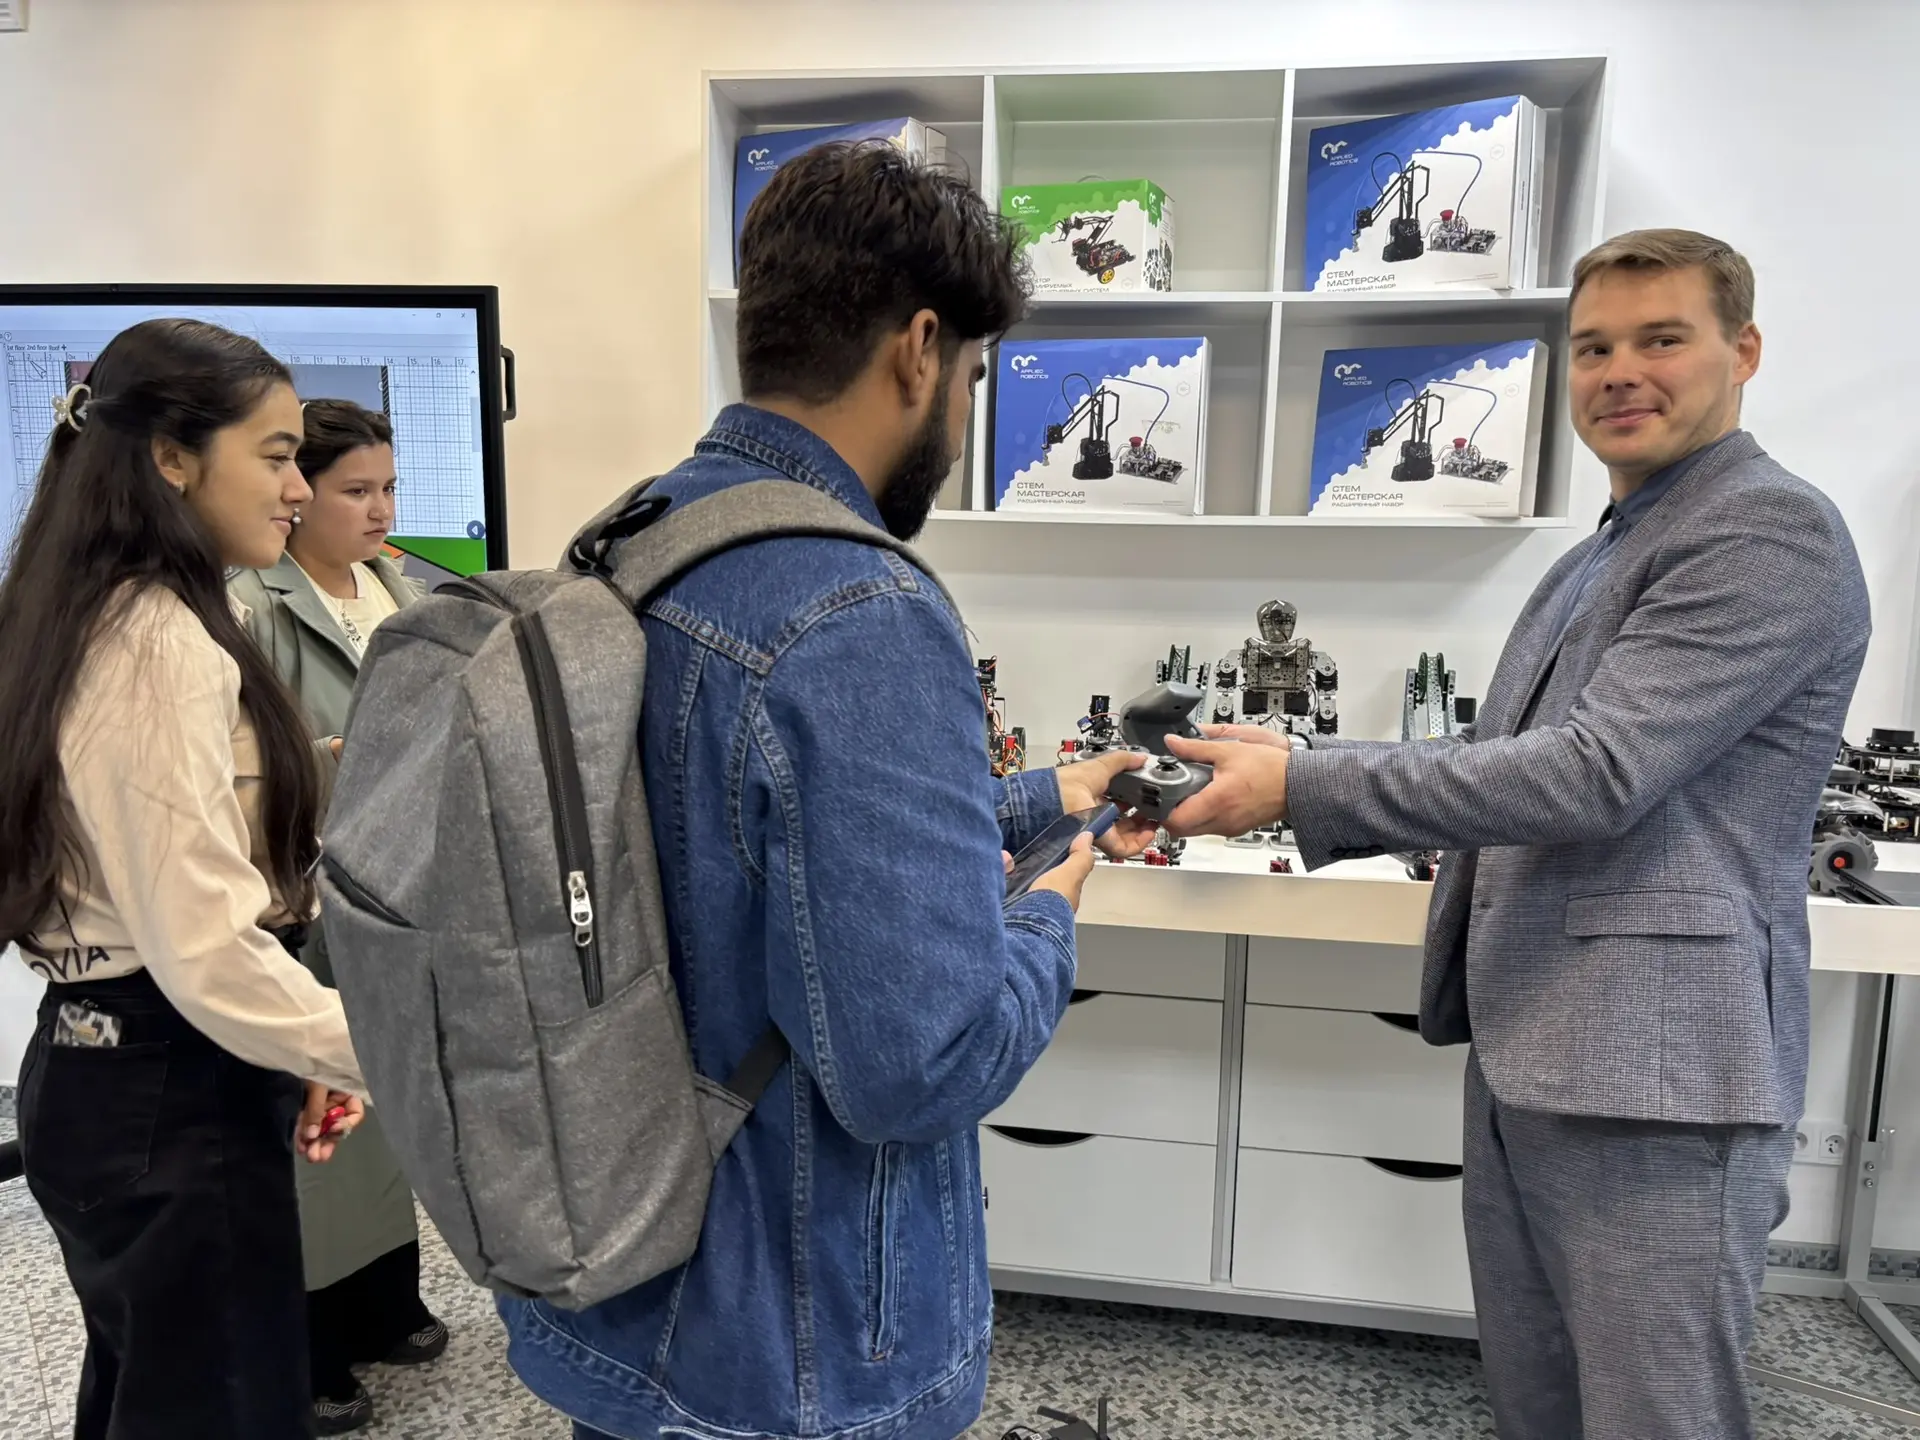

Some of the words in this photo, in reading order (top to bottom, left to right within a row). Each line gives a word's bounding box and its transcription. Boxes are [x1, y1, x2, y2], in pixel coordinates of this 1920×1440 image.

[1331, 153, 1353, 161] APPLIED
[1330, 157, 1359, 166] ROBOTICS
[1326, 270, 1354, 279] СТЕМ
[1326, 274, 1396, 287] МАСТЕРСКАЯ
[316, 356, 323, 364] 11
[1332, 485, 1361, 493] СТЕМ
[1016, 490, 1086, 498] МАСТЕРСКАЯ
[1331, 493, 1404, 501] МАСТЕРСКАЯ
